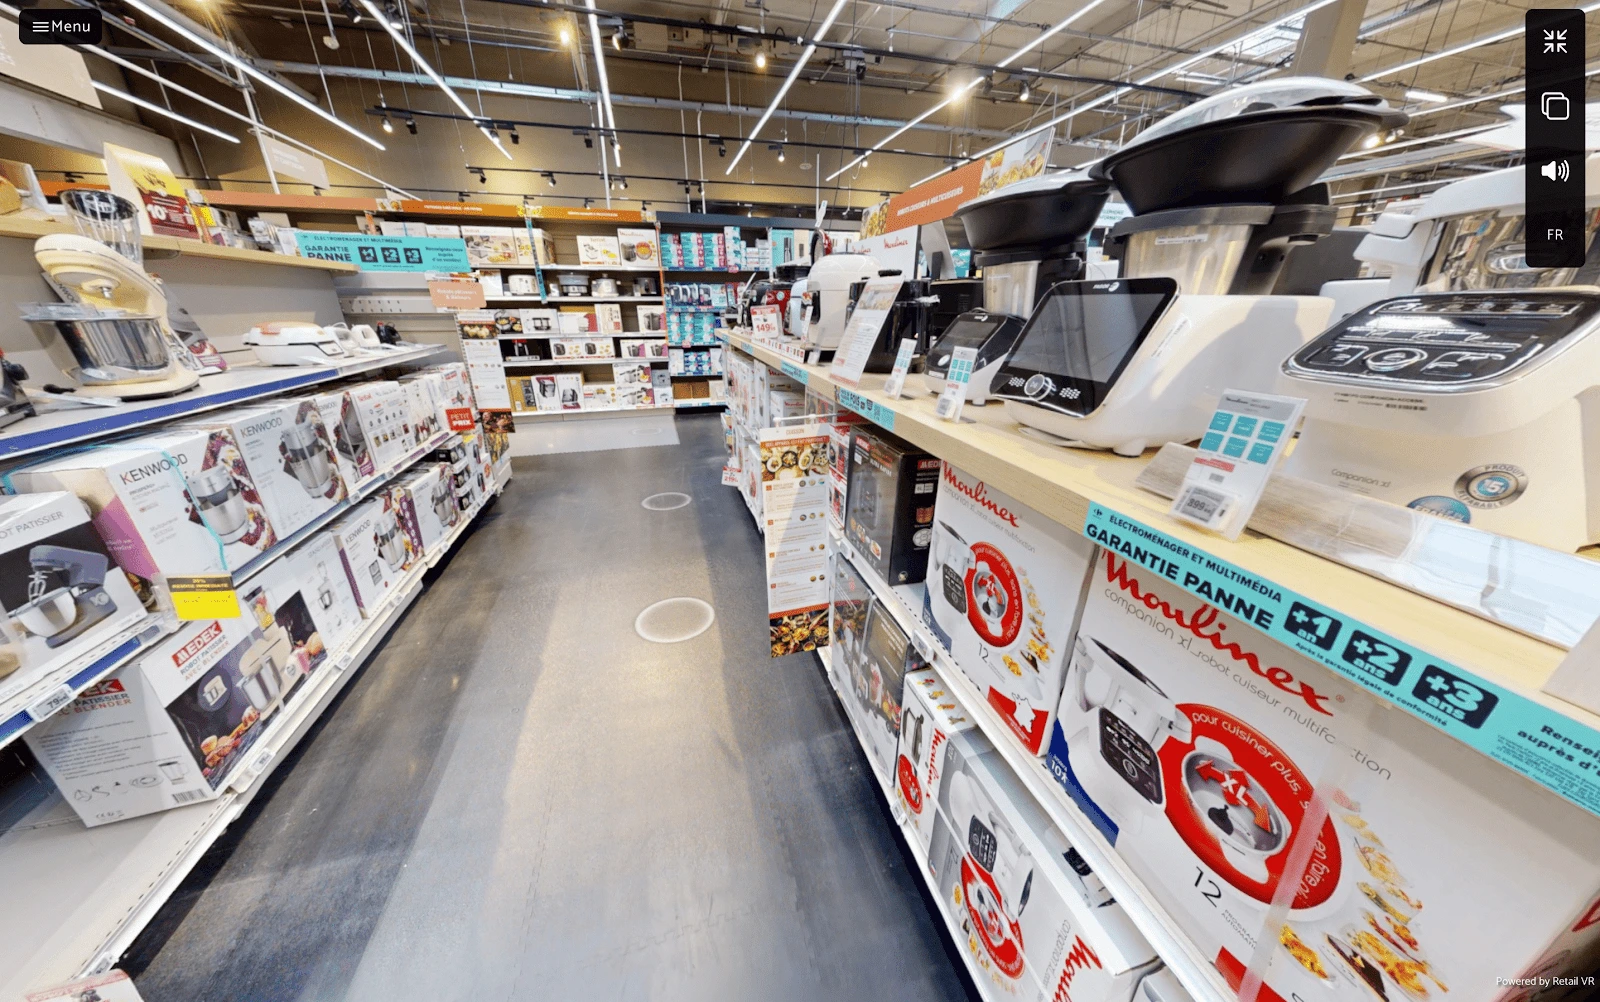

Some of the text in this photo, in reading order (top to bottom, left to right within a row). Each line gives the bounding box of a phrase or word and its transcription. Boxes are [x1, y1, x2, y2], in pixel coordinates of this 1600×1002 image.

[305, 245, 349, 253] GARANTIE
[307, 251, 352, 262] PANNE
[240, 417, 283, 438] KENWOOD
[450, 412, 470, 420] PETIT
[119, 453, 188, 486] KENWOOD
[1331, 468, 1380, 485] Companion
[1380, 480, 1391, 488] xl
[1484, 464, 1526, 478] PRODUIT
[943, 460, 1019, 528] Moulinex
[15, 510, 64, 532] PATISSIER
[345, 519, 371, 544] KENWOOD
[1109, 514, 1282, 603] ÉLECTROMÉNAGER ET MULTIMÉDIA
[986, 579, 996, 594] XL
[1086, 523, 1275, 630] GARANTIE PANNE
[1101, 549, 1334, 716] Moulinex
[1292, 609, 1333, 638] +1
[1297, 628, 1318, 644] an
[174, 621, 221, 664] MEDEK
[979, 642, 989, 664] 12
[1104, 588, 1174, 639] companion
[1232, 673, 1282, 708] cuiseur
[1352, 638, 1400, 673] +2
[180, 656, 201, 675] ROBOT
[1353, 657, 1387, 680] ans
[1295, 642, 1316, 656] Après
[1324, 656, 1356, 678] garantie
[1357, 674, 1383, 692] légale
[1383, 689, 1395, 699] de
[1395, 695, 1448, 727] conformité
[1425, 674, 1485, 712] +3
[75, 699, 132, 714] BLENDER
[1425, 694, 1467, 721] ans
[1192, 712, 1219, 726] pour
[1221, 720, 1274, 758] cuisiner
[1517, 729, 1576, 762] auprès
[1220, 772, 1249, 807] XL
[1194, 865, 1222, 908] 12
